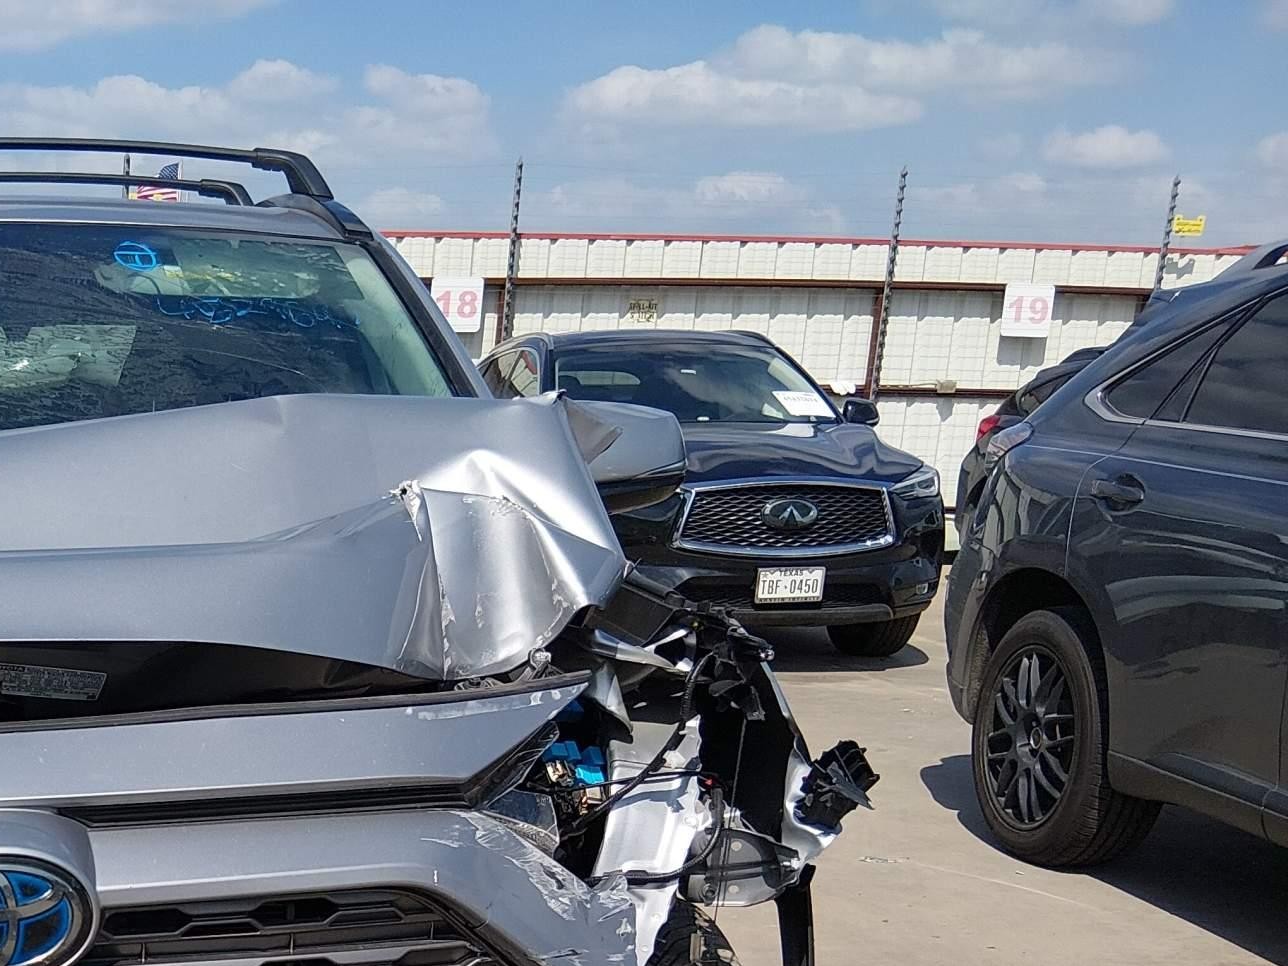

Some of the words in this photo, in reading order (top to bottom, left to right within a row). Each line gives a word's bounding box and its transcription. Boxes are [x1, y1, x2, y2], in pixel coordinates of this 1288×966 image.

[436, 289, 478, 319] 18
[1008, 295, 1049, 325] 19
[778, 568, 804, 577] TEXAS
